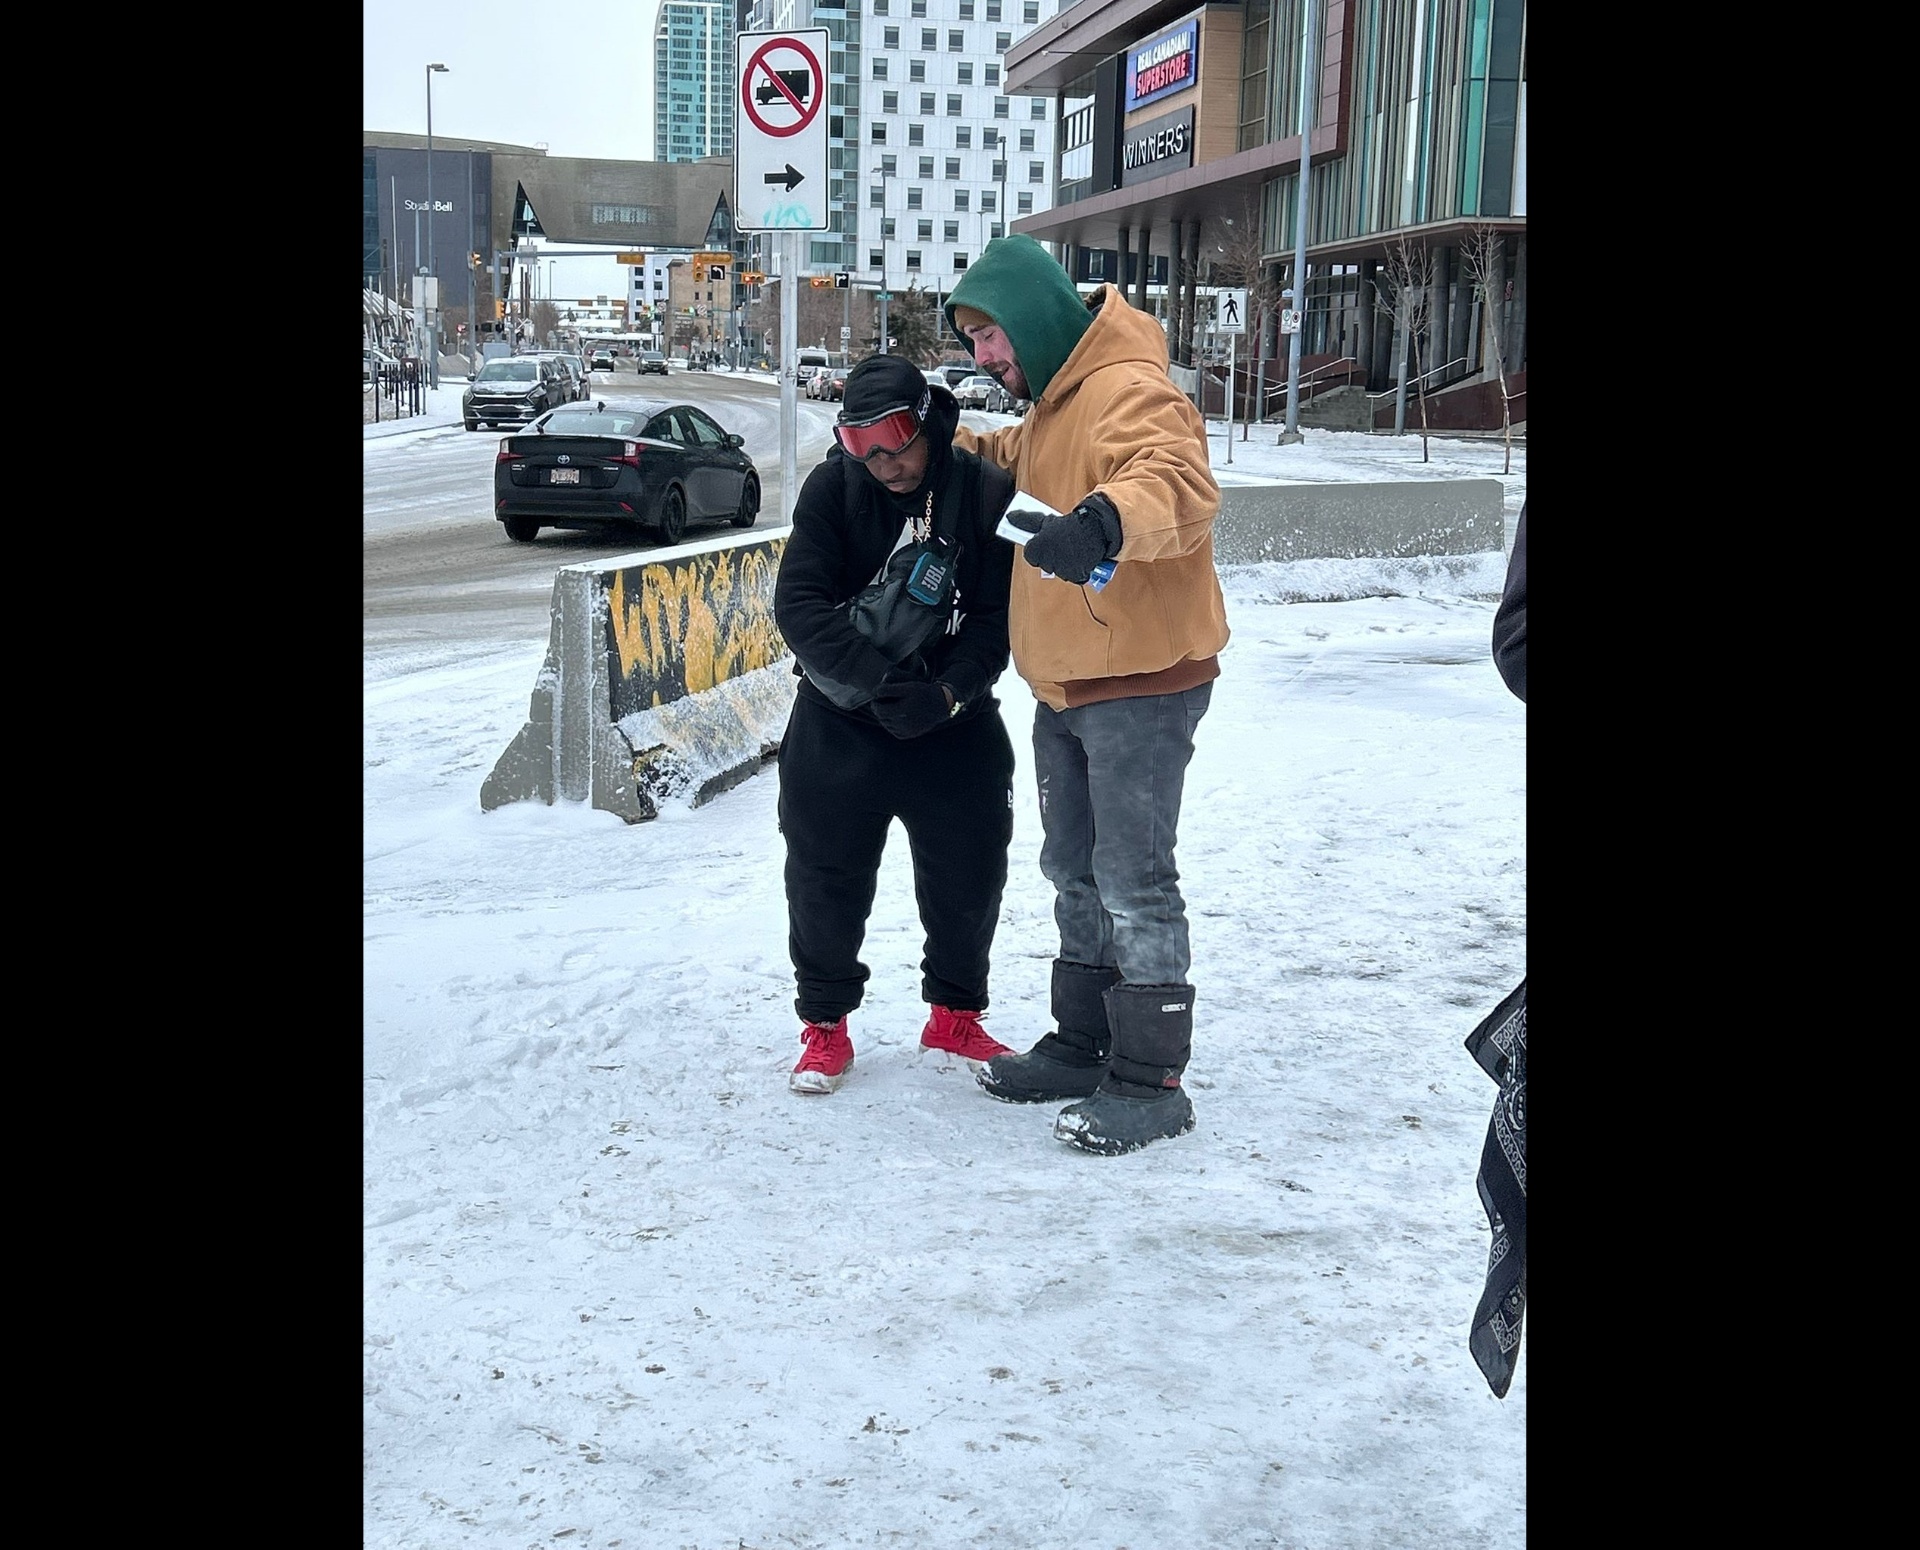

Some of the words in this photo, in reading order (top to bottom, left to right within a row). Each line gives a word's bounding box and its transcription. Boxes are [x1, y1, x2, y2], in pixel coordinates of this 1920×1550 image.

[1137, 49, 1152, 73] REAL
[1153, 31, 1191, 66] CANADIAN
[1136, 53, 1187, 98] SUPERSTORE
[1122, 123, 1184, 170] WINNERS
[434, 200, 453, 212] Bell
[921, 564, 947, 592] JBL
